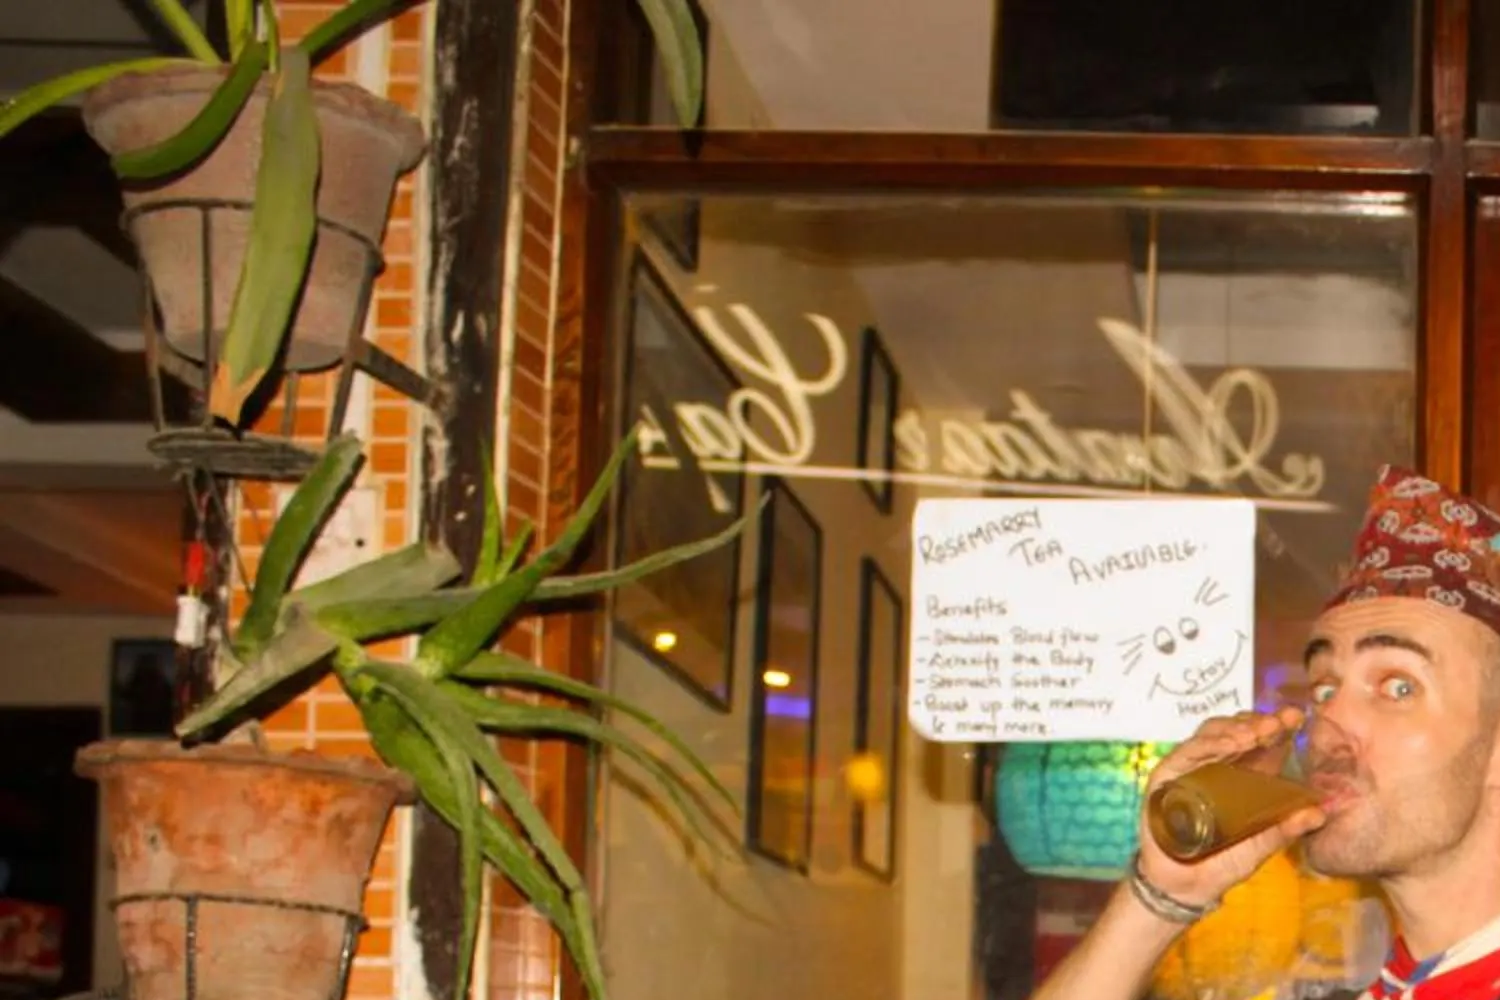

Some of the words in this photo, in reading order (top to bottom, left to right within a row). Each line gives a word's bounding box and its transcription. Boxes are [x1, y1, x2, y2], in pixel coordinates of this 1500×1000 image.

[918, 506, 1042, 565] ROSEMARRY
[926, 594, 1008, 619] Benefits
[1050, 649, 1095, 674] Body
[980, 700, 1003, 720] up
[1011, 698, 1041, 712] the
